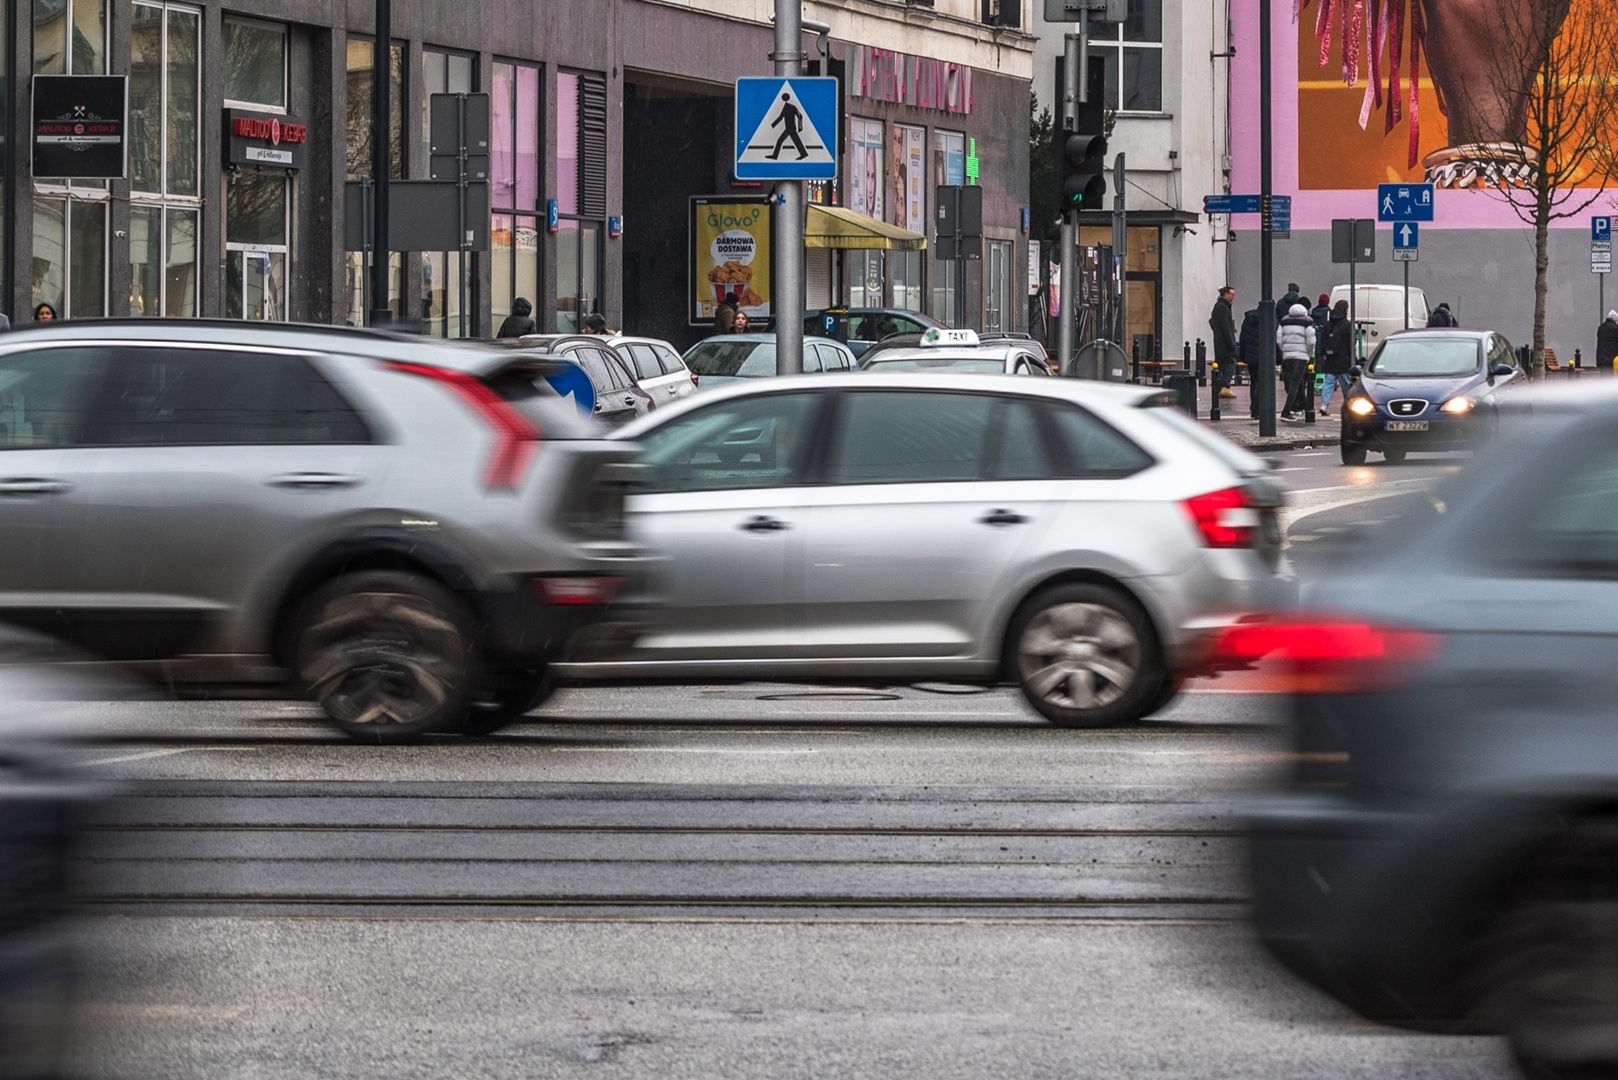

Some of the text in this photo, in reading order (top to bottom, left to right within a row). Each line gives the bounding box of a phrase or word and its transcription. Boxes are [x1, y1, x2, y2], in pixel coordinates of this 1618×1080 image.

[707, 212, 753, 227] Glovo
[1595, 218, 1607, 234] P
[716, 237, 754, 245] DARMOWA
[718, 245, 752, 253] DOSTAWA
[826, 316, 834, 330] P
[948, 332, 968, 342] TAXI
